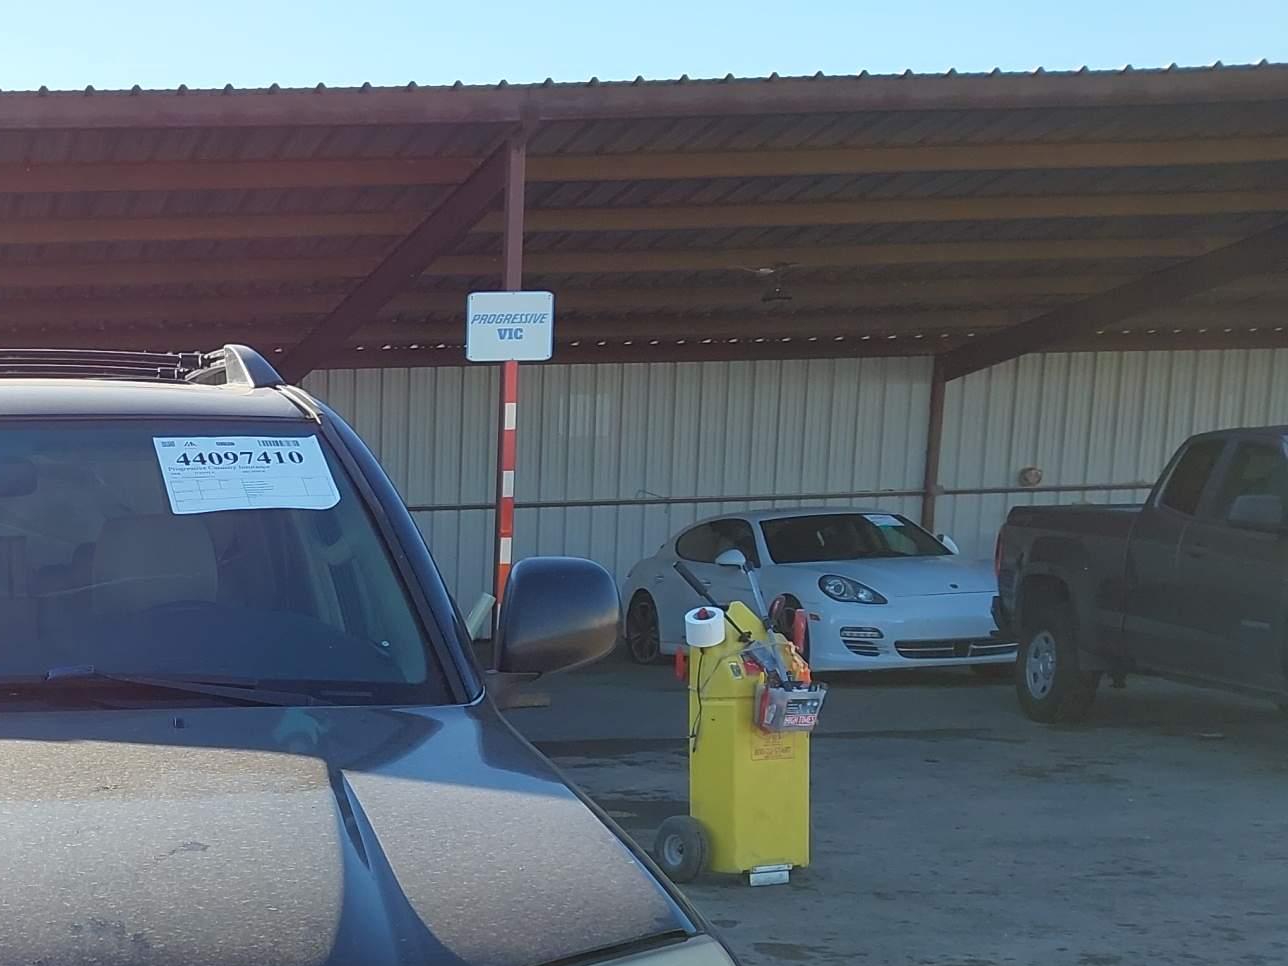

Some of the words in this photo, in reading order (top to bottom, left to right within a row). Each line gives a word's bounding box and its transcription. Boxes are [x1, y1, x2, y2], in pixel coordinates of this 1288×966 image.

[471, 313, 548, 324] PROGRESSIVE
[497, 328, 524, 340] VIC
[176, 451, 304, 466] 44097410
